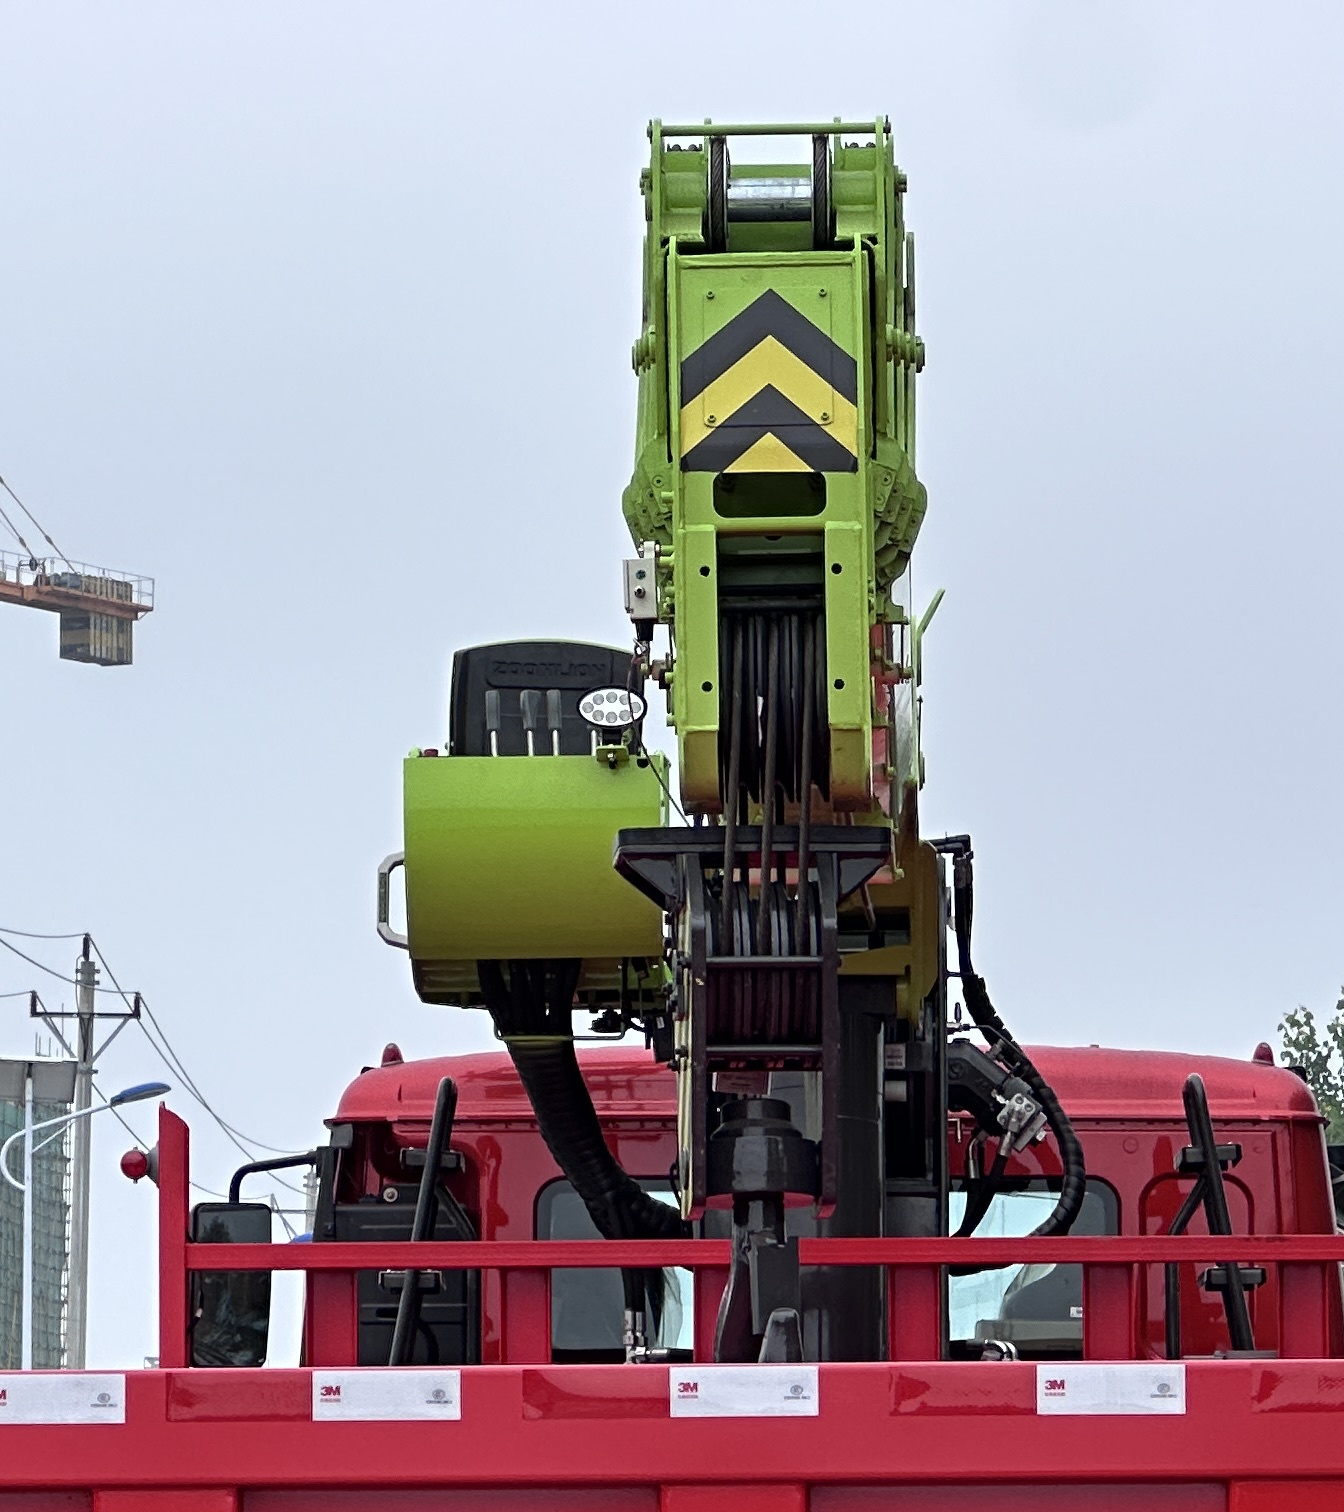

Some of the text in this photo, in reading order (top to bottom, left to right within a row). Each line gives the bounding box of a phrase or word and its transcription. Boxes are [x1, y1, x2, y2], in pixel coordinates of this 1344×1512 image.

[320, 1385, 341, 1397] 3M
[678, 1382, 699, 1393] 3M
[1045, 1379, 1066, 1391] 3M
